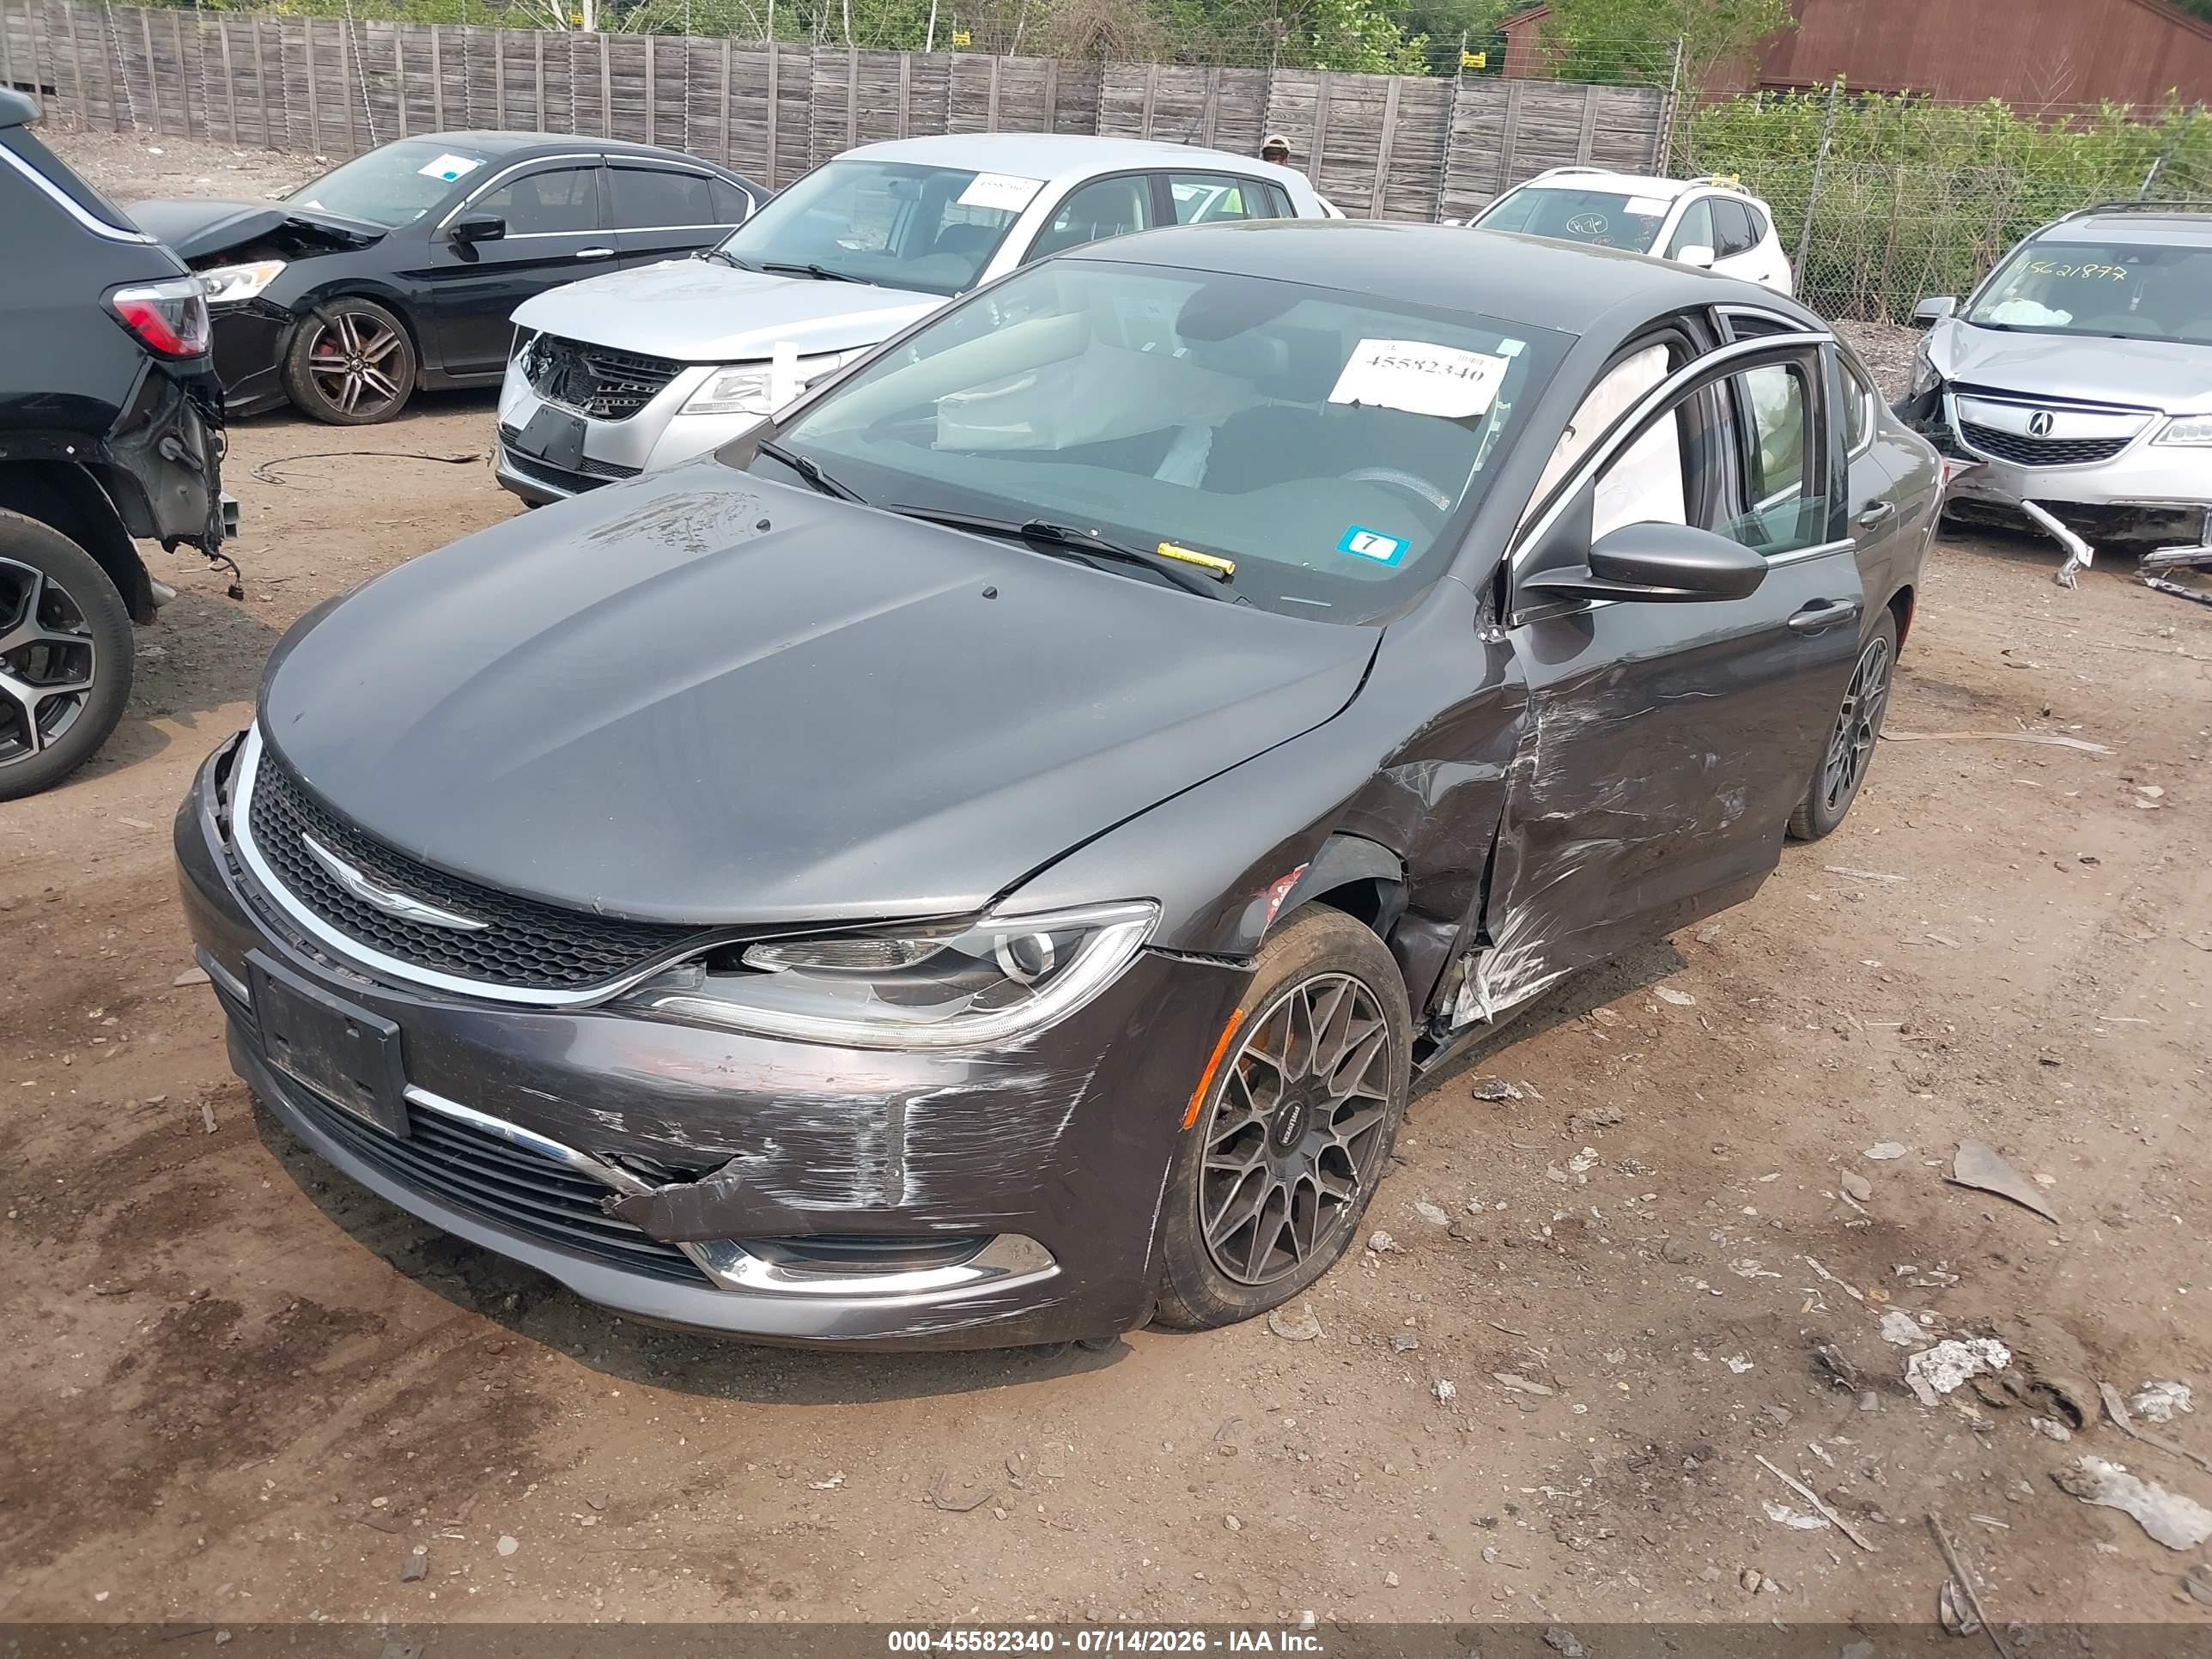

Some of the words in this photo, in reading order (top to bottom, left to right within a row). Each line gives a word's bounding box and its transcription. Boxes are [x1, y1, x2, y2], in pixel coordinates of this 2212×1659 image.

[2014, 261, 2128, 282] 45621877
[1366, 356, 1486, 381] 45582340
[1362, 535, 1379, 550] 7
